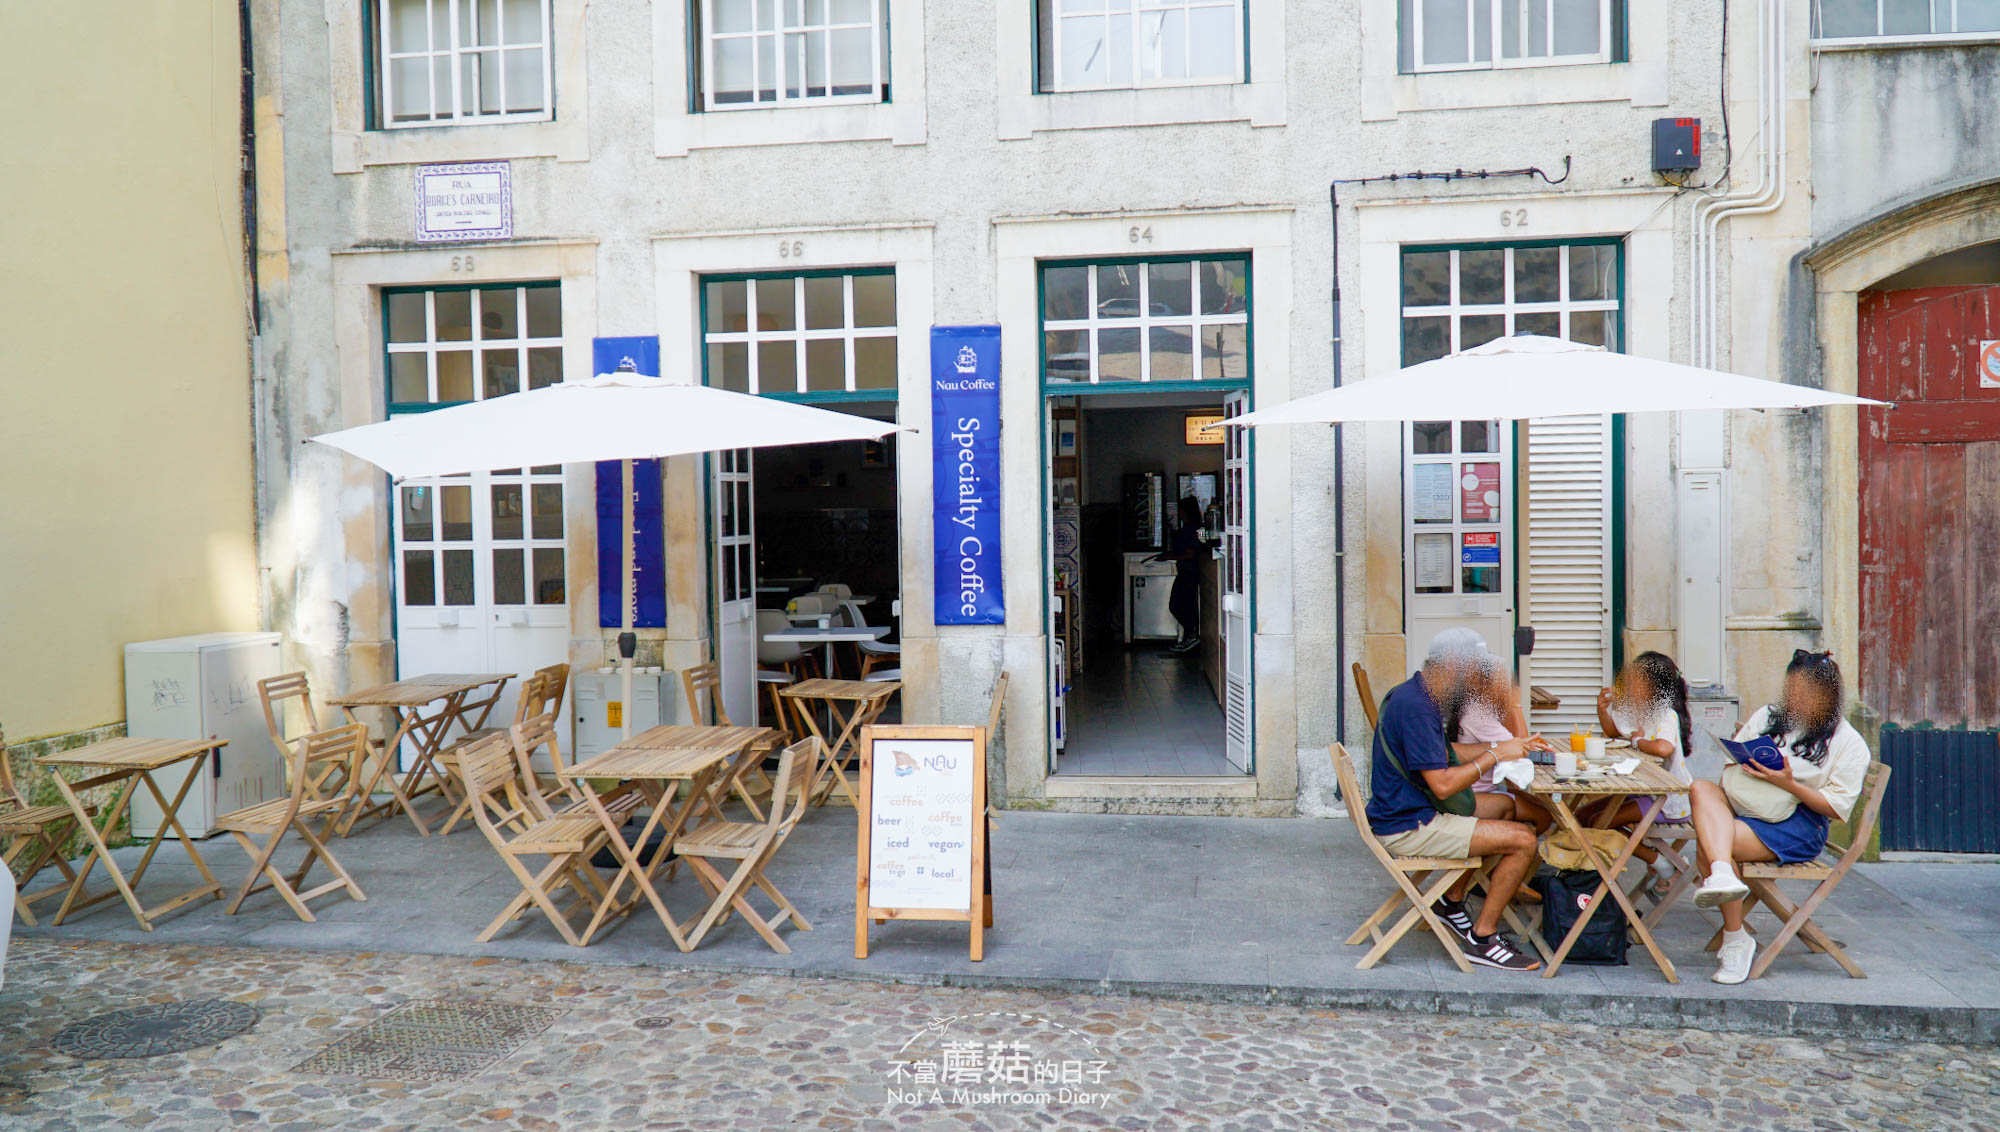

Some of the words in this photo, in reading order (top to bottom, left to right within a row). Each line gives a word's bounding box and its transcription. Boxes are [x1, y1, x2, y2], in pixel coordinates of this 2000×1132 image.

[453, 181, 472, 190] RUA
[460, 193, 500, 205] CARNEIRO
[1499, 208, 1529, 227] 62
[1128, 225, 1153, 244] 64
[779, 240, 804, 258] 66
[451, 255, 475, 272] 68
[936, 380, 959, 391] Nau
[960, 378, 996, 391] Coffee
[951, 417, 983, 530] Specialty
[959, 536, 985, 618] Coffee
[924, 755, 957, 771] NAU
[890, 796, 925, 807] coffee
[878, 814, 902, 825] beer
[928, 812, 963, 823] coffee
[887, 836, 910, 848] iced
[928, 841, 961, 853] vegan
[932, 868, 954, 878] local
